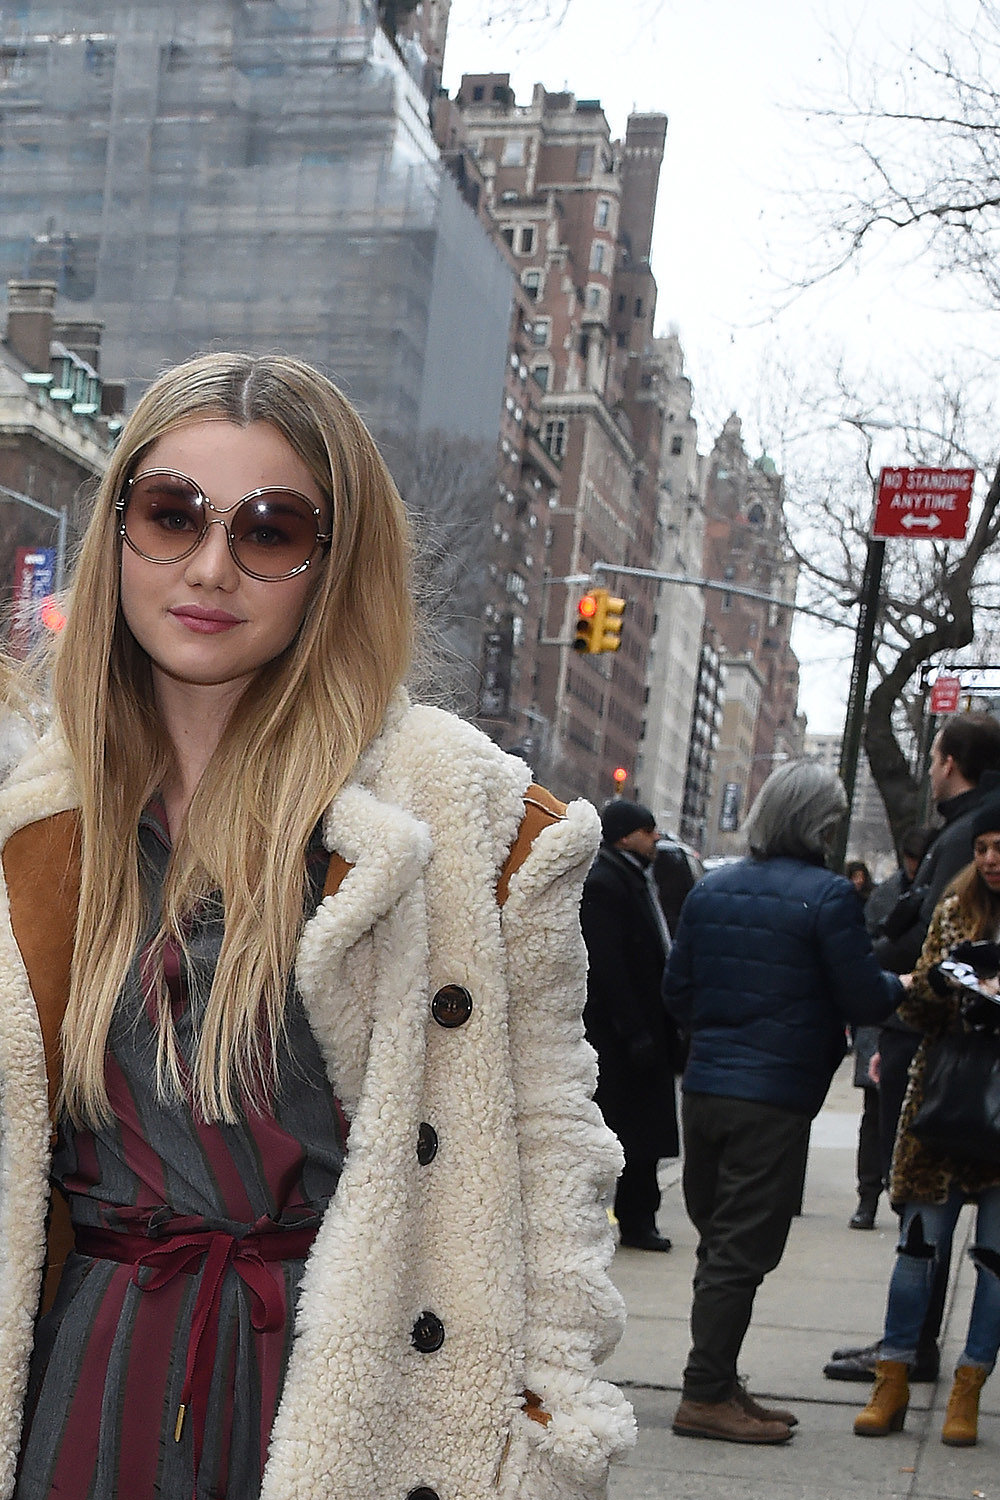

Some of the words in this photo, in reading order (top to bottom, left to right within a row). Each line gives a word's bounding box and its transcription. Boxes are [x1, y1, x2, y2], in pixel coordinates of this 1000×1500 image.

[883, 472, 903, 489] NO
[906, 472, 970, 490] STANDING
[890, 493, 957, 511] ANYTIME
